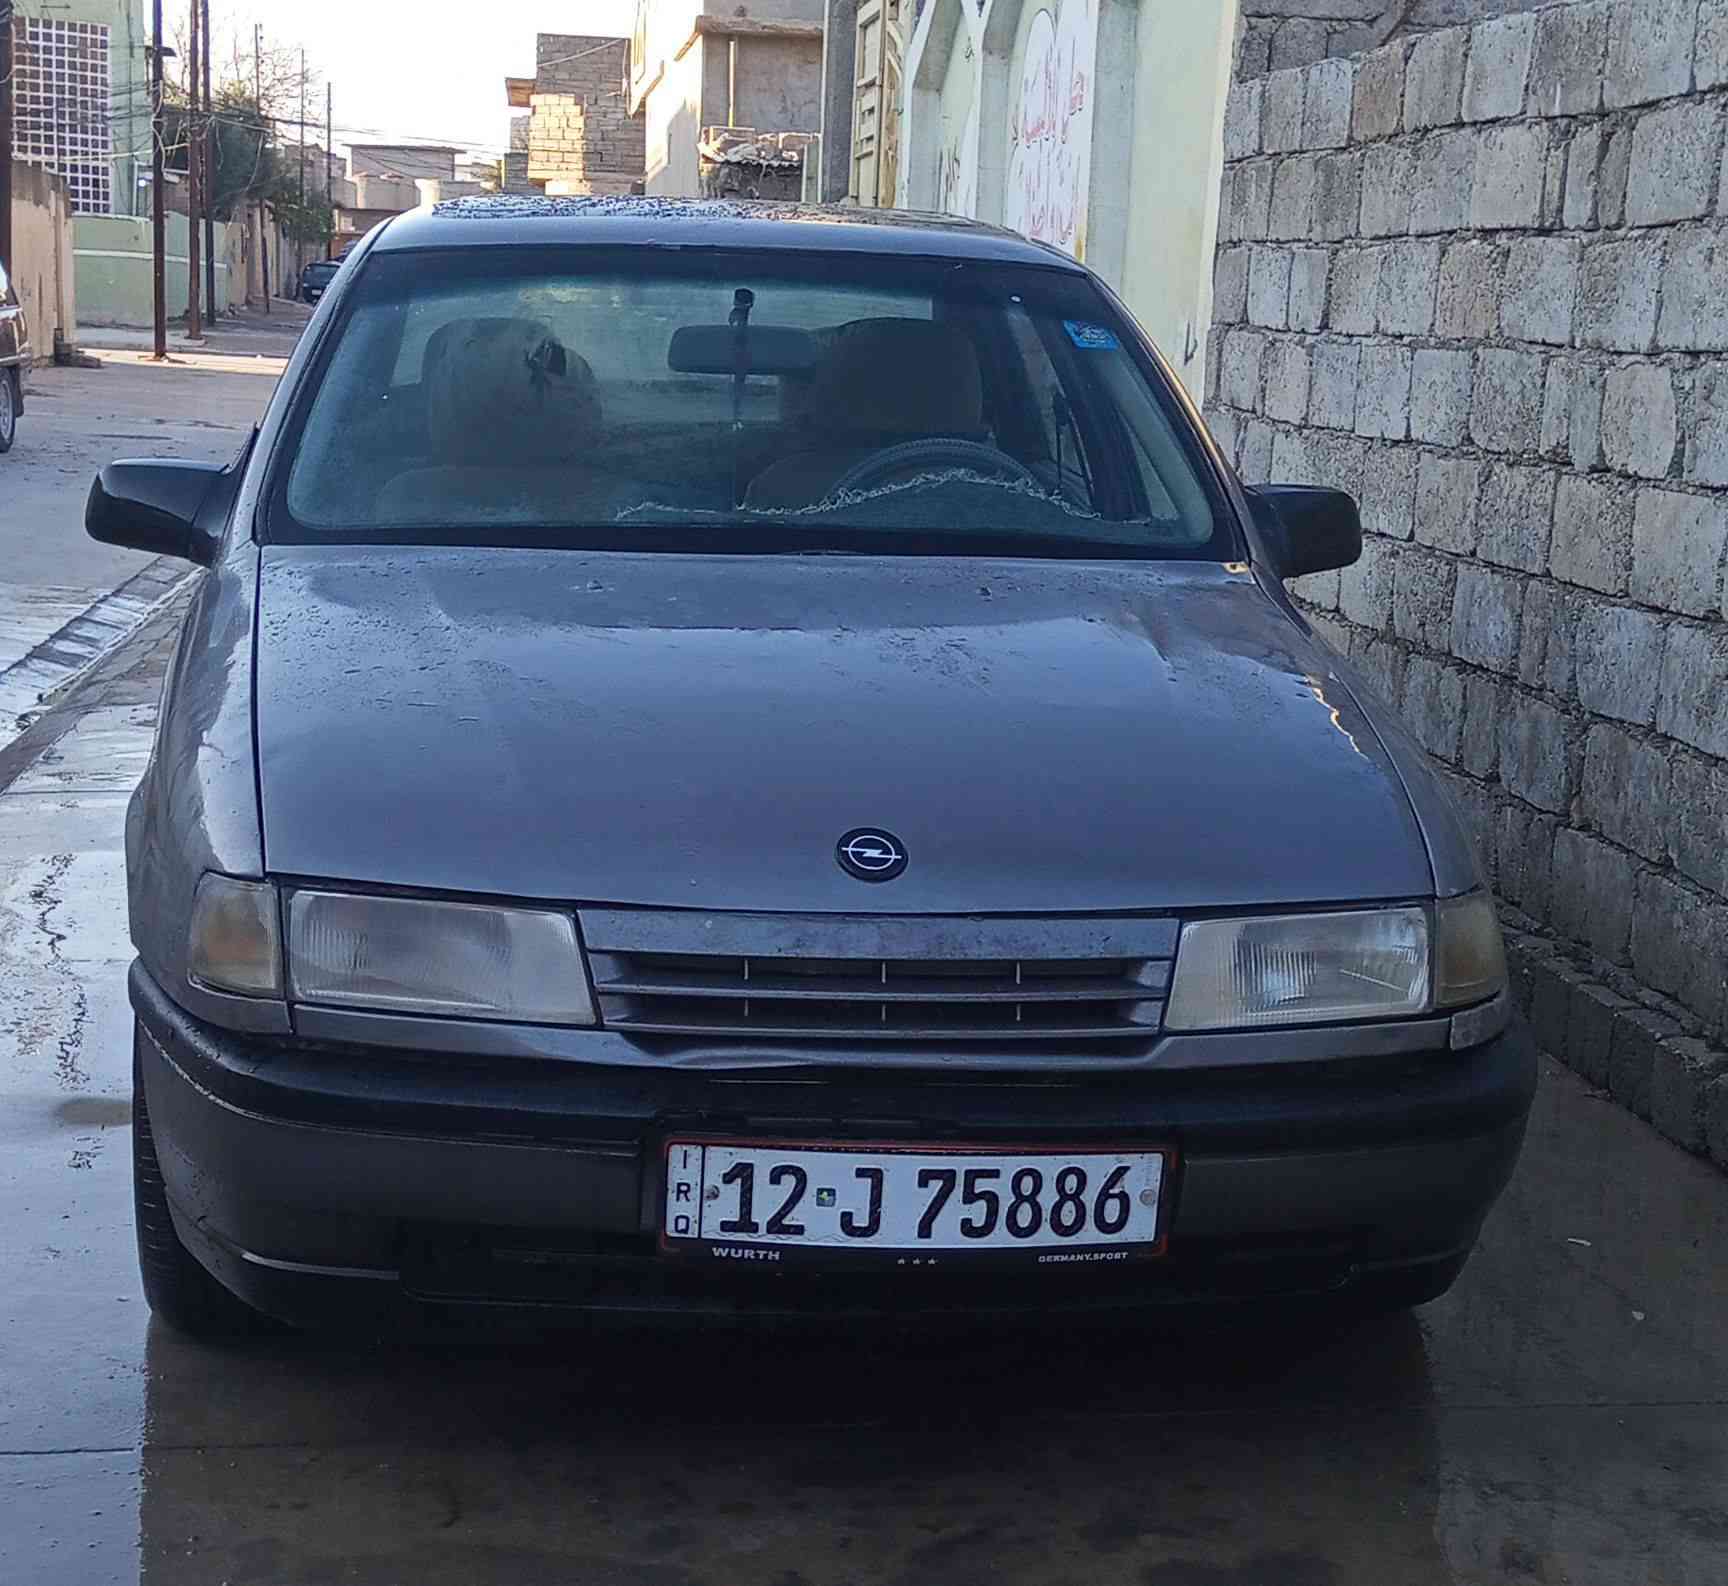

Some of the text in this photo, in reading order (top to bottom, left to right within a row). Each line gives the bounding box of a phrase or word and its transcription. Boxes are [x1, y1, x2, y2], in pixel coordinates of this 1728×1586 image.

[675, 1149, 691, 1235] IRQ
[720, 1162, 1131, 1239] 12 J 75886
[711, 1246, 781, 1261] WURTH
